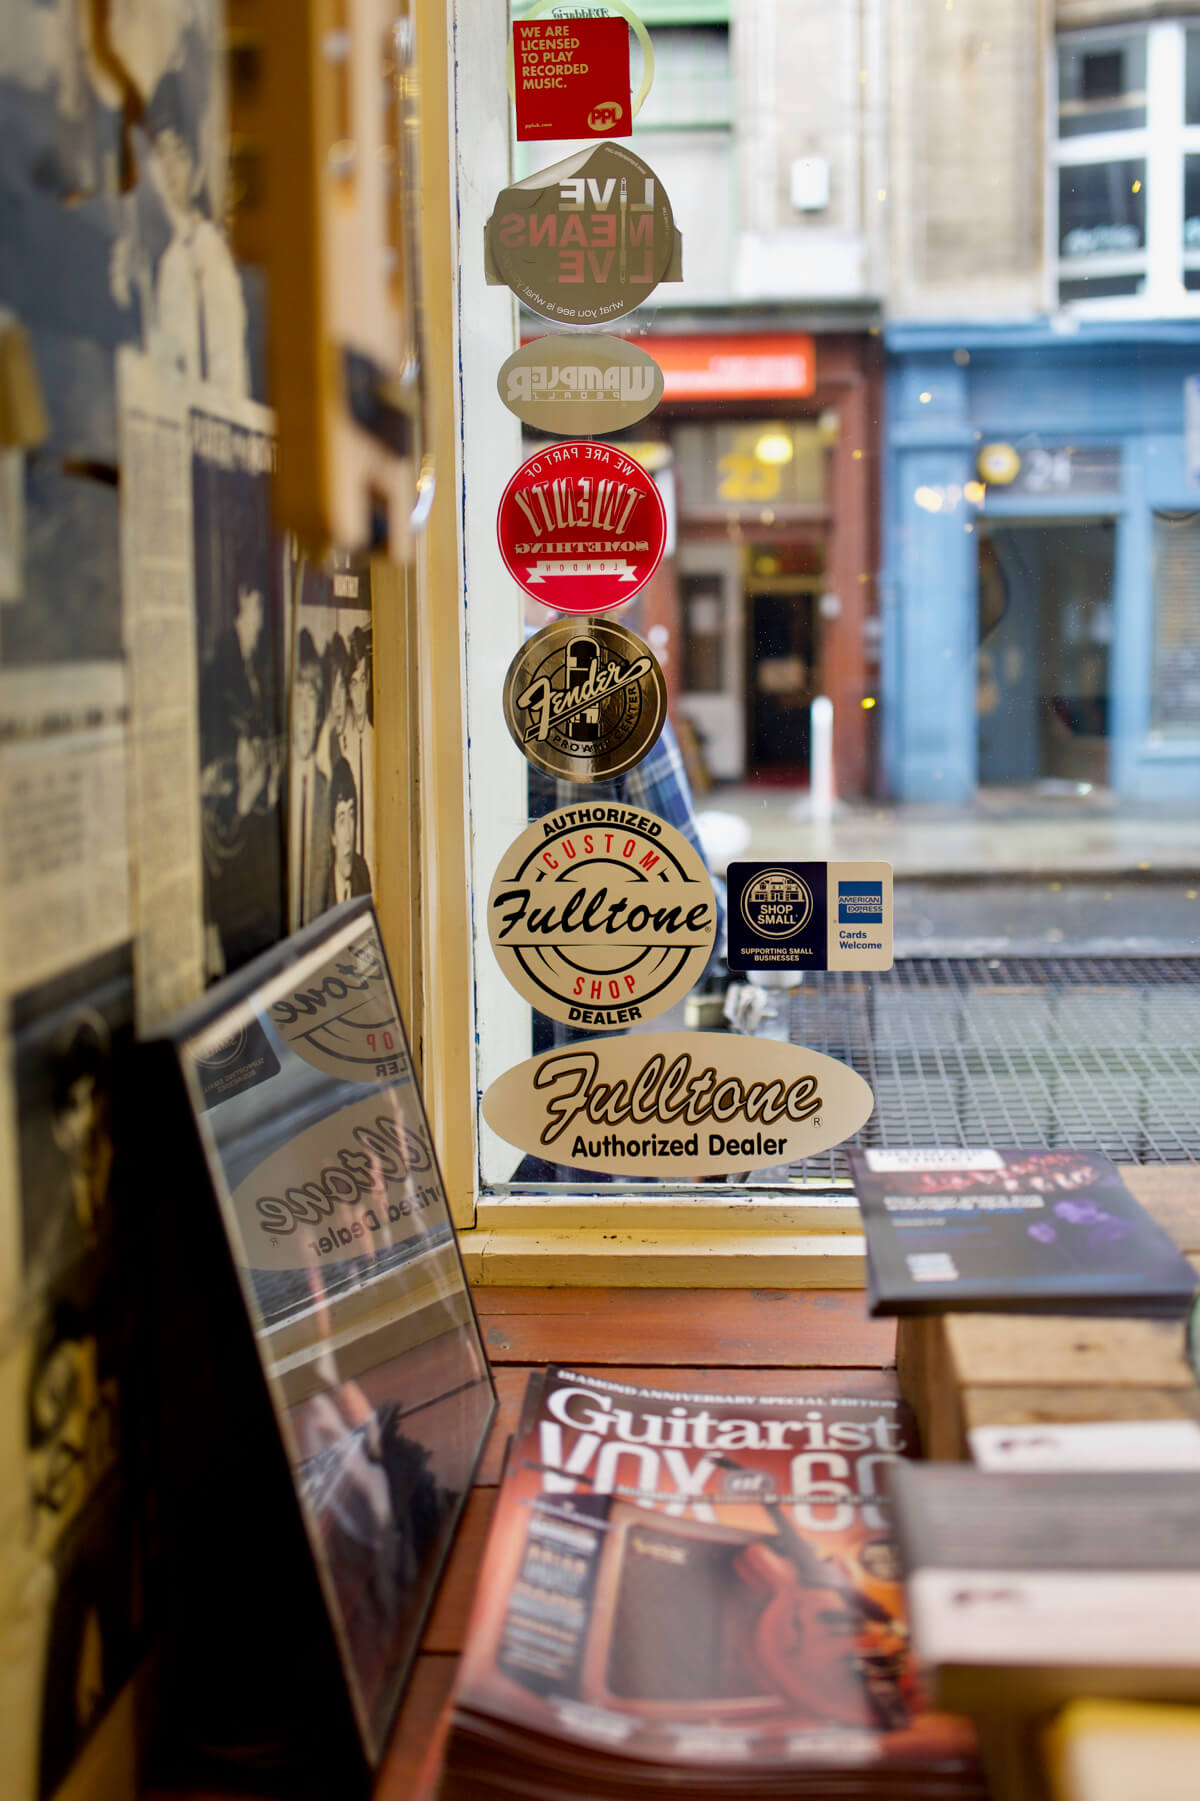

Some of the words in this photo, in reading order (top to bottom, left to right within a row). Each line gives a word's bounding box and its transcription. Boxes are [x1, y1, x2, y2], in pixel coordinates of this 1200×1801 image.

[520, 27, 541, 38] WE
[545, 25, 570, 37] ARE
[521, 38, 580, 51] LICENSED
[521, 53, 539, 64] TO
[543, 51, 574, 63] PLAY
[522, 64, 589, 77] RECORDED
[522, 77, 567, 90] MUSIC.
[516, 656, 653, 743] Fender
[552, 734, 579, 752] PRO
[582, 739, 611, 753] AMP
[615, 685, 638, 740] CENTER
[542, 807, 662, 838] AUTHORIZED
[542, 833, 660, 872] CUSTOM
[838, 896, 880, 905] AMERICAN
[493, 887, 713, 939] Fulltone
[760, 904, 794, 915] SHOP
[846, 905, 883, 913] EXPRESS
[757, 914, 796, 925] SMALL
[839, 930, 867, 939] Cards
[740, 947, 788, 955] SUPPORTING
[788, 947, 814, 955] SMALL
[839, 940, 882, 949] Welcome
[754, 954, 800, 962] BUSINESSES
[572, 974, 636, 1000] SHOP
[568, 1006, 643, 1025] DEALER
[533, 1051, 823, 1145] Fulltone
[571, 1133, 699, 1158] Authorized
[708, 1133, 788, 1157] Dealer
[547, 1386, 907, 1453] Guitarist
[539, 1420, 724, 1524] VOX
